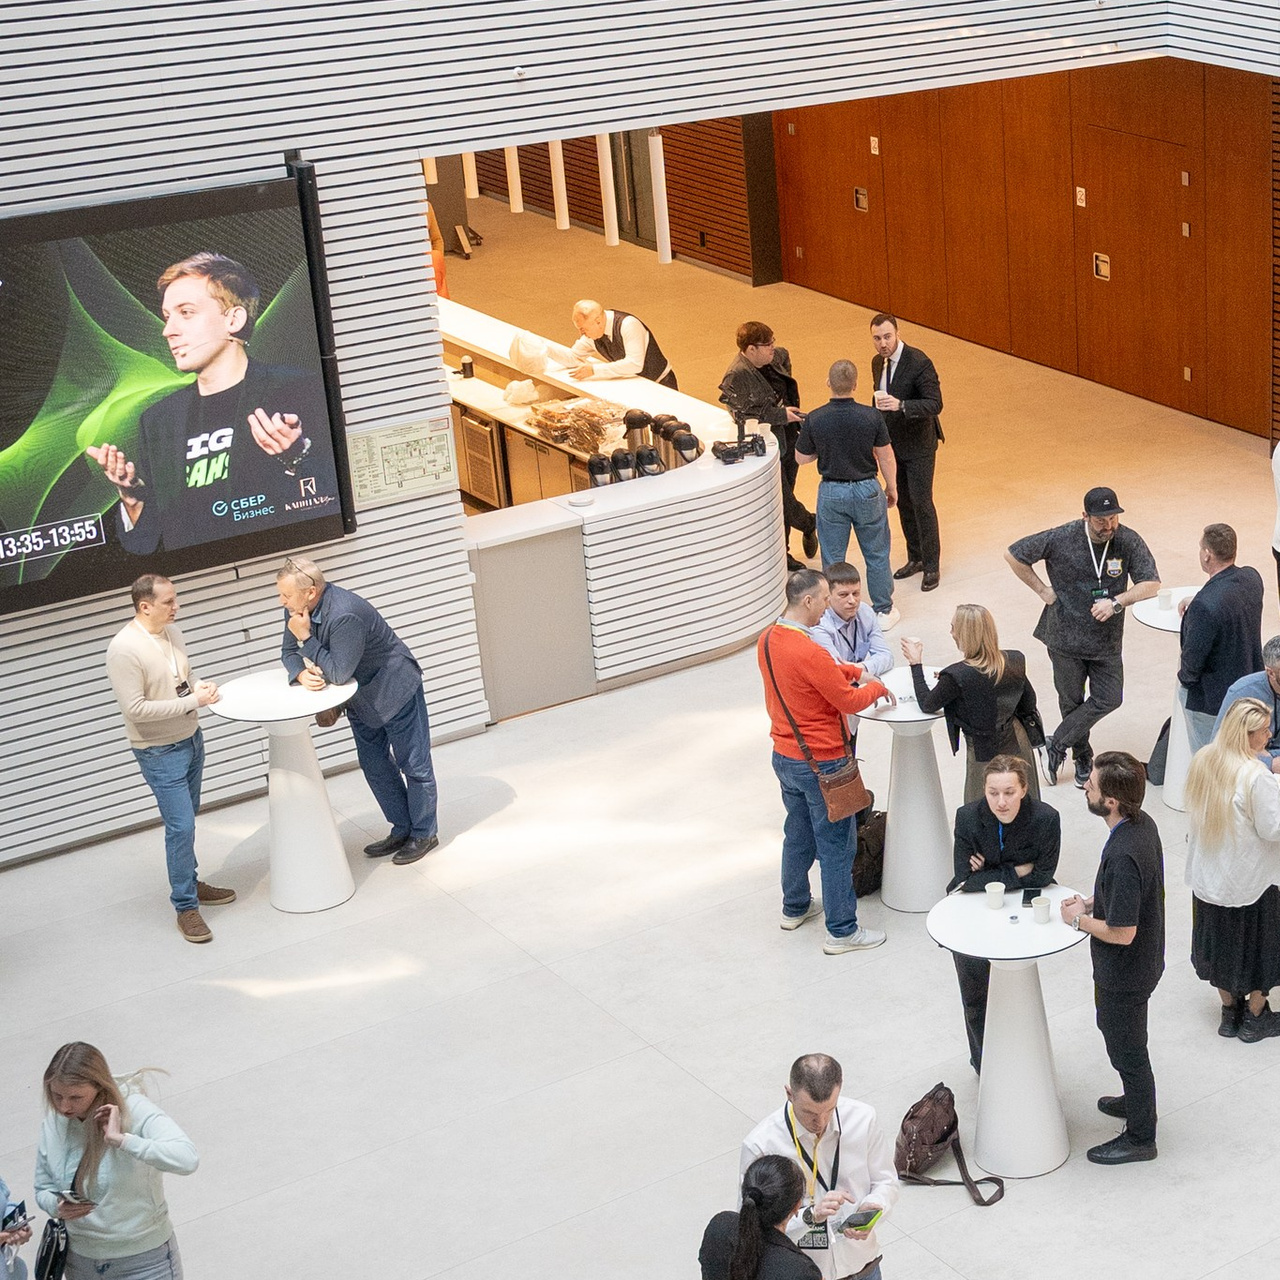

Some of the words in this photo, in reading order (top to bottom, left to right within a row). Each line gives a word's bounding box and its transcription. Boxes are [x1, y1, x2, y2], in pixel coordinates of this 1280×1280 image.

[231, 494, 266, 510] СБЕР
[233, 505, 275, 522] Бизнес
[0, 520, 97, 559] 13:35-13:55
